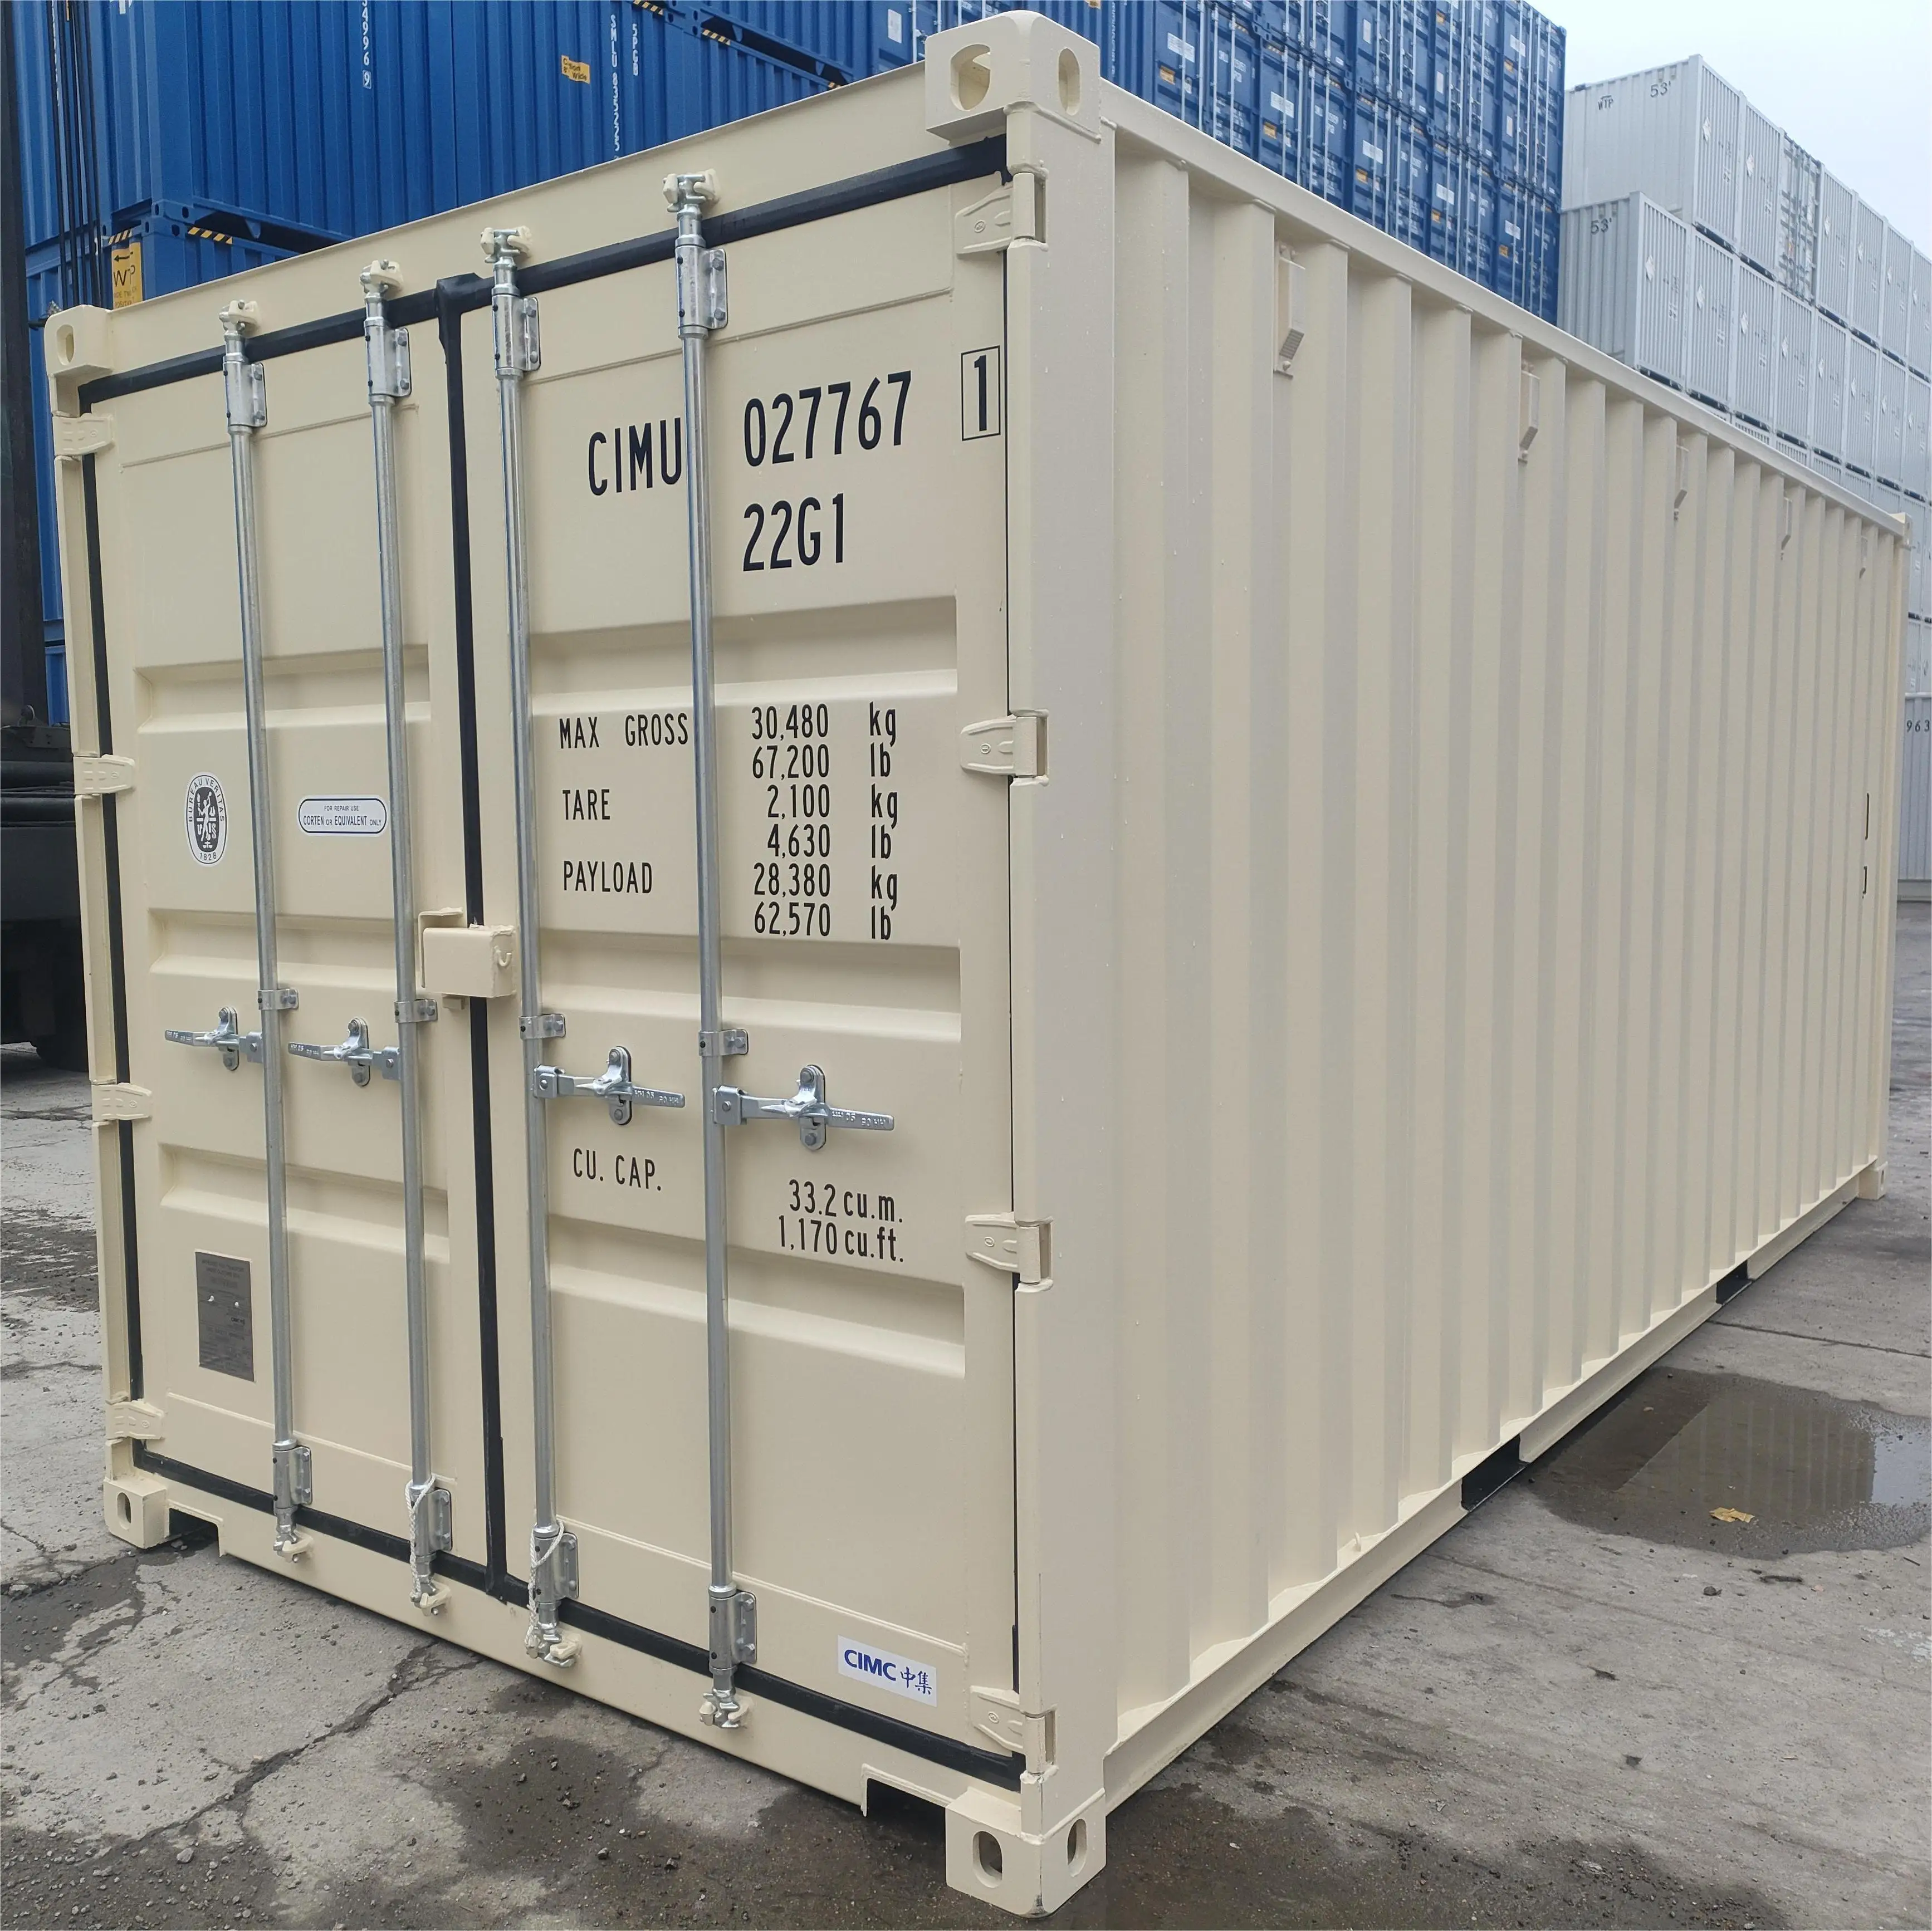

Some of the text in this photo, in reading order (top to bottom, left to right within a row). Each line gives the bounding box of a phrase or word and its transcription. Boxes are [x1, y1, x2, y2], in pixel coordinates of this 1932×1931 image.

[1597, 98, 1614, 110] WTP
[1650, 80, 1671, 97] 53'
[1591, 217, 1612, 235] 53'
[588, 354, 988, 496] CIMU 027767 1
[743, 493, 844, 572] 22G1
[559, 701, 896, 749] MAX GROSS 30,480 kg
[1906, 719, 1930, 733] 963
[752, 742, 891, 781] 67,200 lb
[188, 778, 224, 822] BUREAU VERITAS
[303, 815, 324, 826] CORTEN
[335, 815, 367, 826] EQUIVALENT
[562, 783, 898, 830] TARE 2,100 kg
[200, 852, 217, 861] 1828
[767, 824, 891, 859] 4,630 lb
[564, 860, 897, 912] PAYLOAD 28,380 kg
[754, 901, 891, 940] 62,570 lb
[573, 1148, 661, 1191] CU. CAP.
[789, 1179, 903, 1223] 33.2 cu.m.
[779, 1215, 903, 1263] 1,170 cu.ft.
[844, 1649, 932, 1695] CIMC 中集
